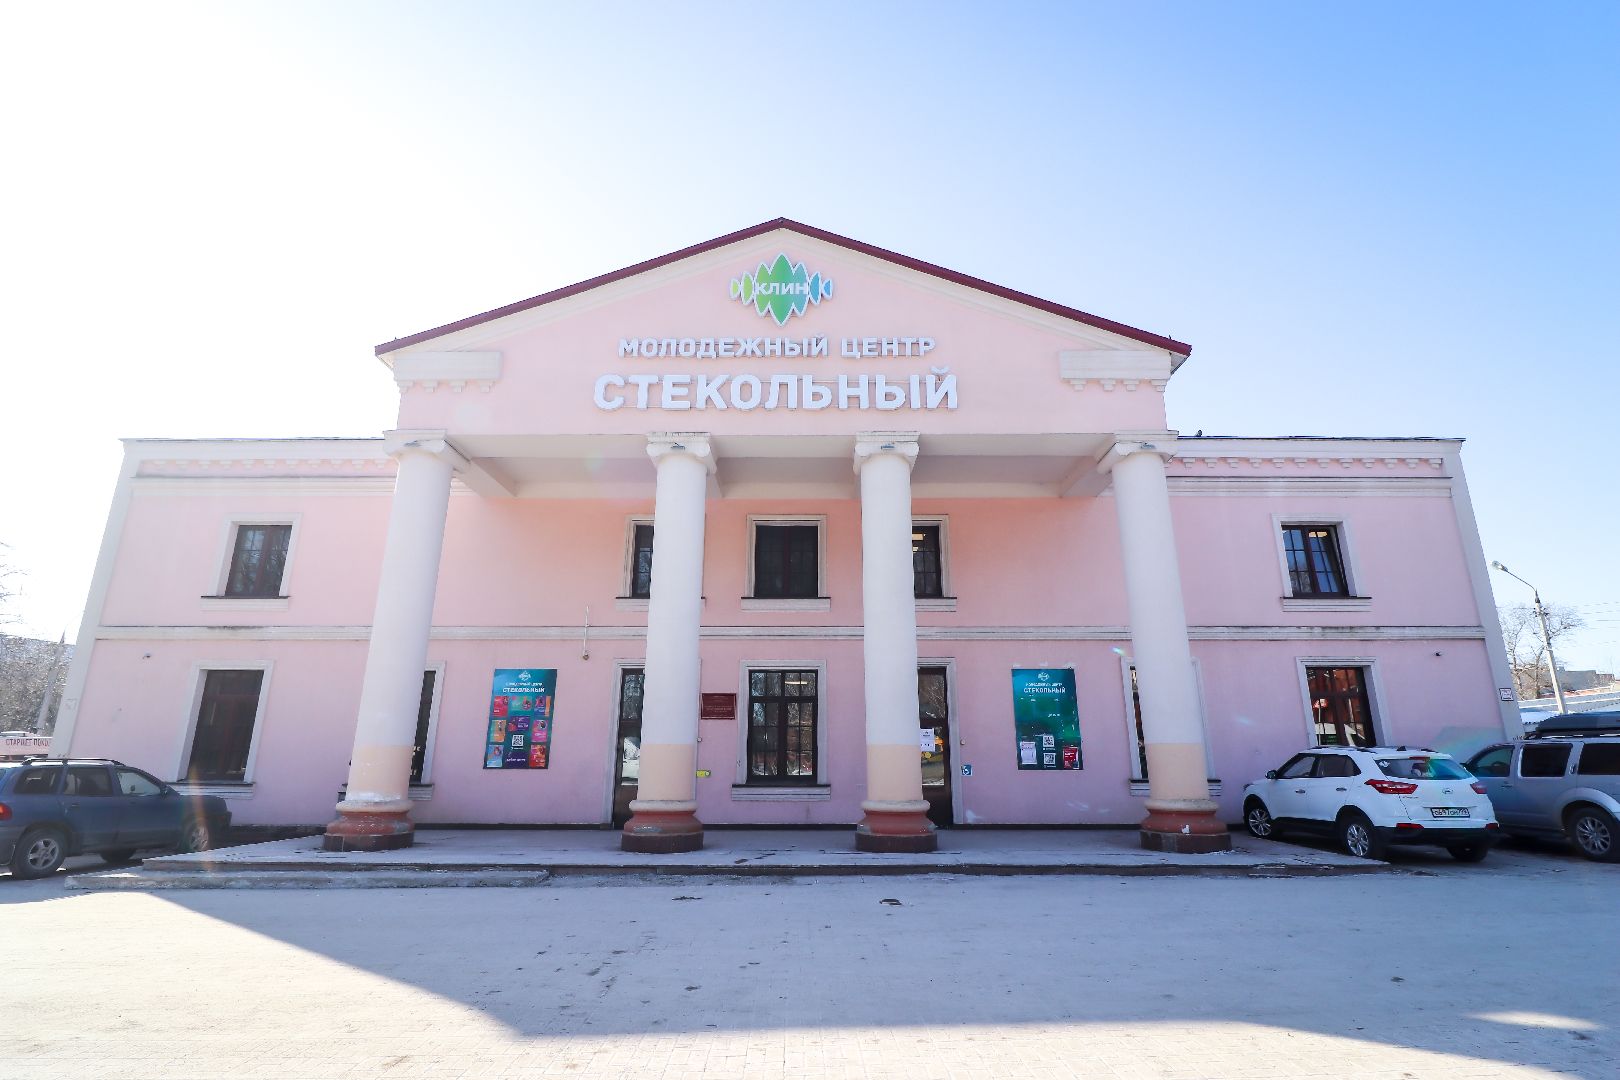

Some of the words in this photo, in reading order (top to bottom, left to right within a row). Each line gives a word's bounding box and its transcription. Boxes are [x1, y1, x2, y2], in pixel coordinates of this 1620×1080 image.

[757, 282, 809, 295] КЛИН
[618, 333, 828, 358] МОЛОДЕЖНЫЙ
[841, 336, 936, 359] ЦЕНТР
[594, 365, 958, 410] СТЕКОЛЬНЫЙ
[1023, 686, 1066, 694] СТЕКОЛЬНЫЙ
